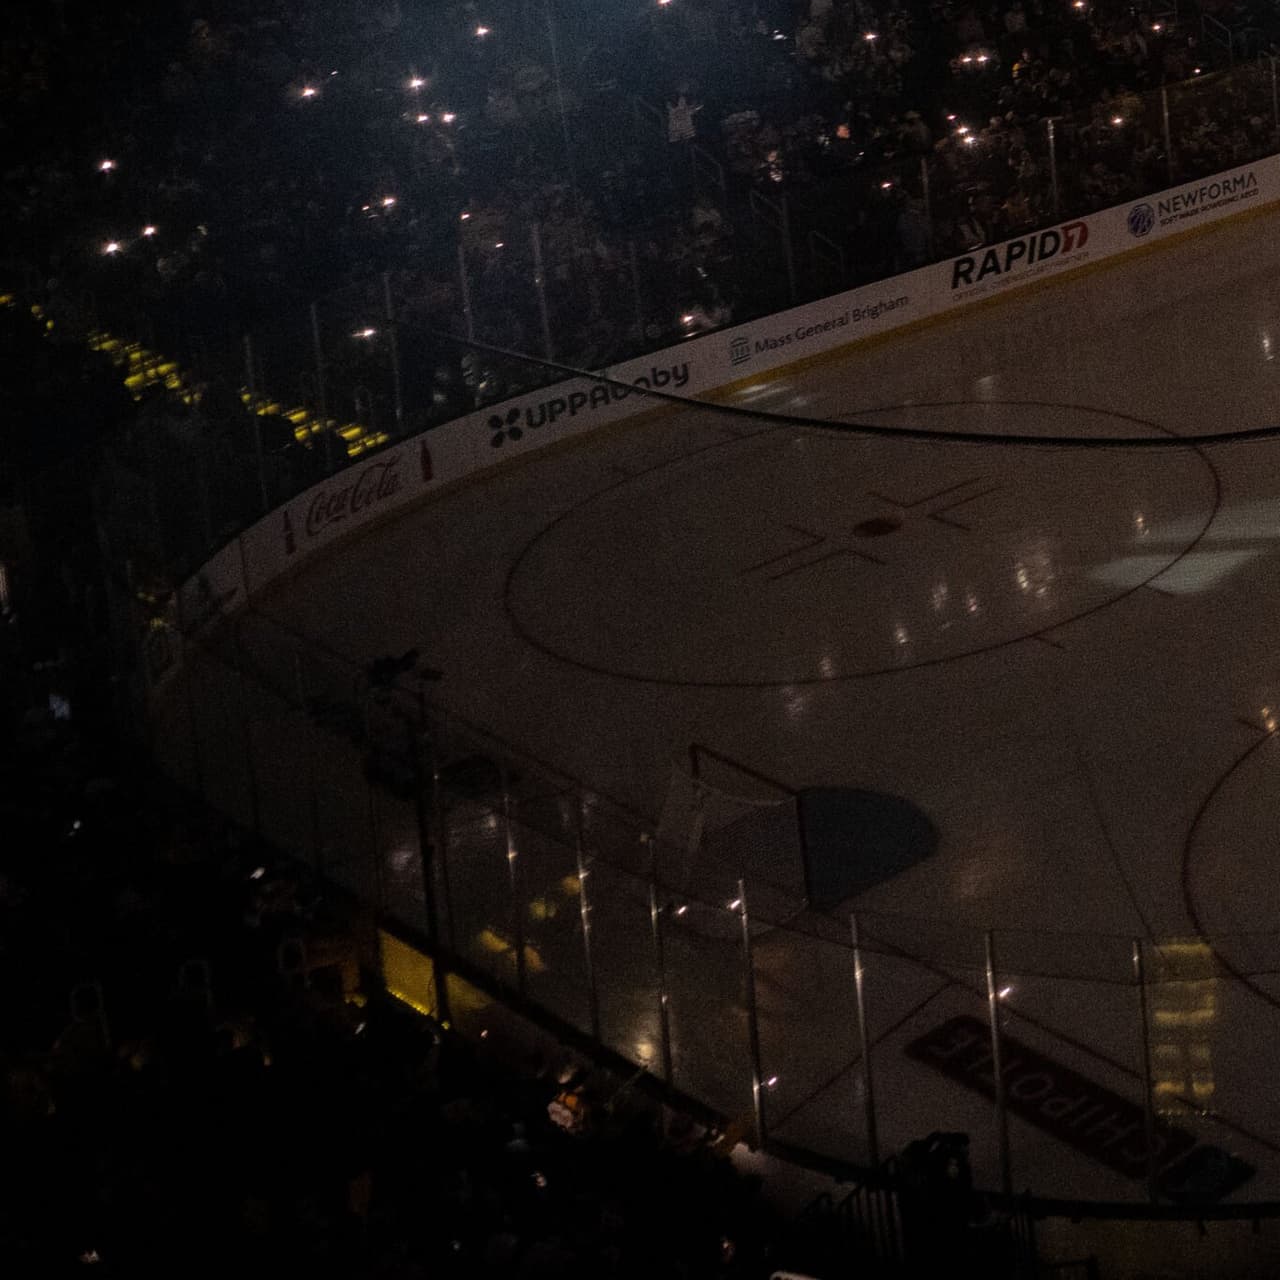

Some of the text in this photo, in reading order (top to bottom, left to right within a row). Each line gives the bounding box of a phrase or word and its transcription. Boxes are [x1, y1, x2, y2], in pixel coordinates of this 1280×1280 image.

[1157, 171, 1258, 218] NEWFORMA
[951, 220, 1089, 290] RAPID7
[754, 293, 909, 355] Mass General Brigham
[306, 456, 399, 537] Coca-Cola
